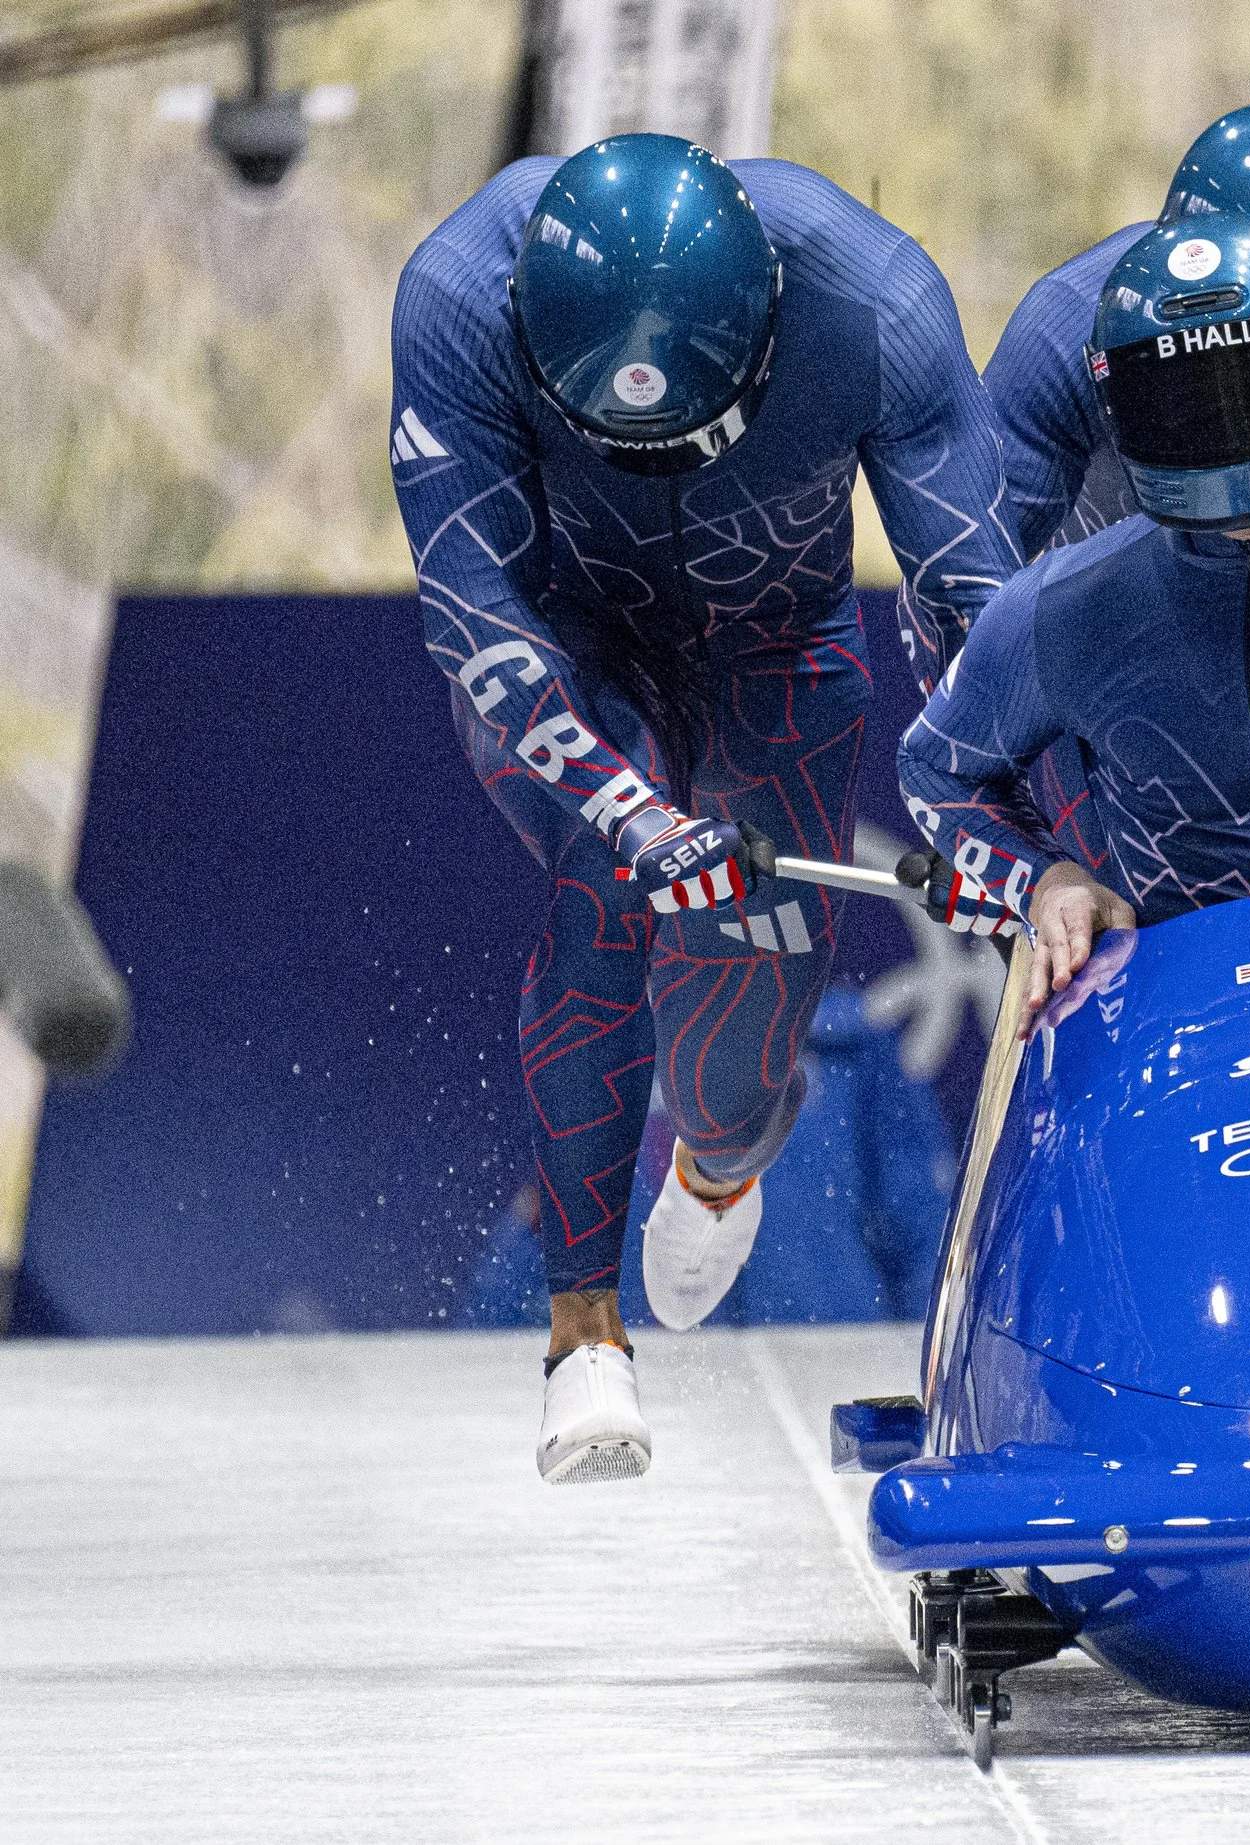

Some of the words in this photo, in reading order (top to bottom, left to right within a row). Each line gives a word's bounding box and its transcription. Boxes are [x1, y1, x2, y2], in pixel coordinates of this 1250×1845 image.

[1157, 334, 1176, 359] B
[458, 640, 654, 836] GBR
[659, 830, 723, 879] SEIZ
